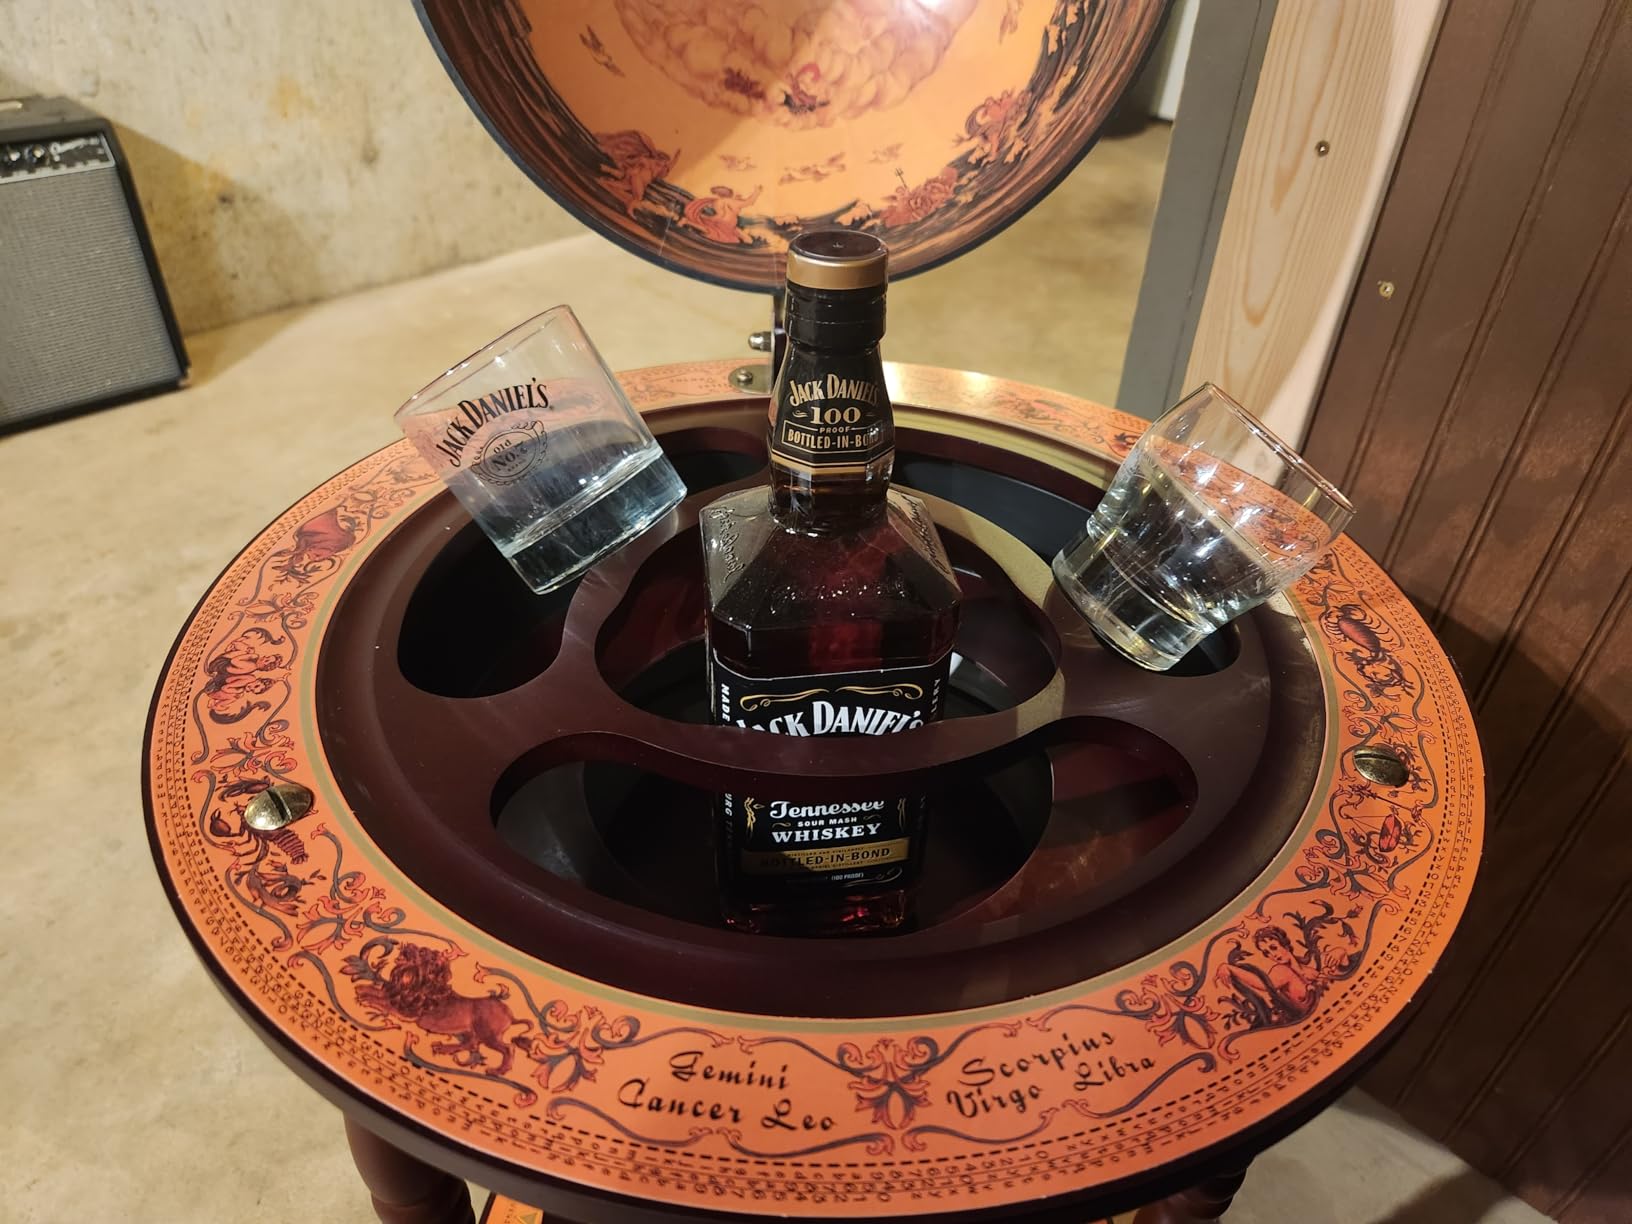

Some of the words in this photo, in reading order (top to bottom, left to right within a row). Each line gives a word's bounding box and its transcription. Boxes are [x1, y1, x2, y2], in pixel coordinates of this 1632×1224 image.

[789, 380, 825, 407] JACK
[436, 416, 475, 468] JACK
[457, 377, 549, 430] DANIEL'S
[810, 406, 861, 425] 100
[819, 426, 851, 434] PROOF
[721, 683, 731, 722] MADE
[769, 799, 885, 819] Tennessee
[797, 818, 825, 828] SOUR
[829, 816, 857, 826] MASH
[771, 822, 882, 843] WHISKEY
[669, 1050, 788, 1091] Gemini
[957, 1031, 1115, 1088] Scorpius
[946, 1084, 1043, 1119] Virgo
[1073, 1055, 1155, 1092] Libra
[618, 1077, 742, 1124] Cancer
[760, 1098, 835, 1131] Leo
